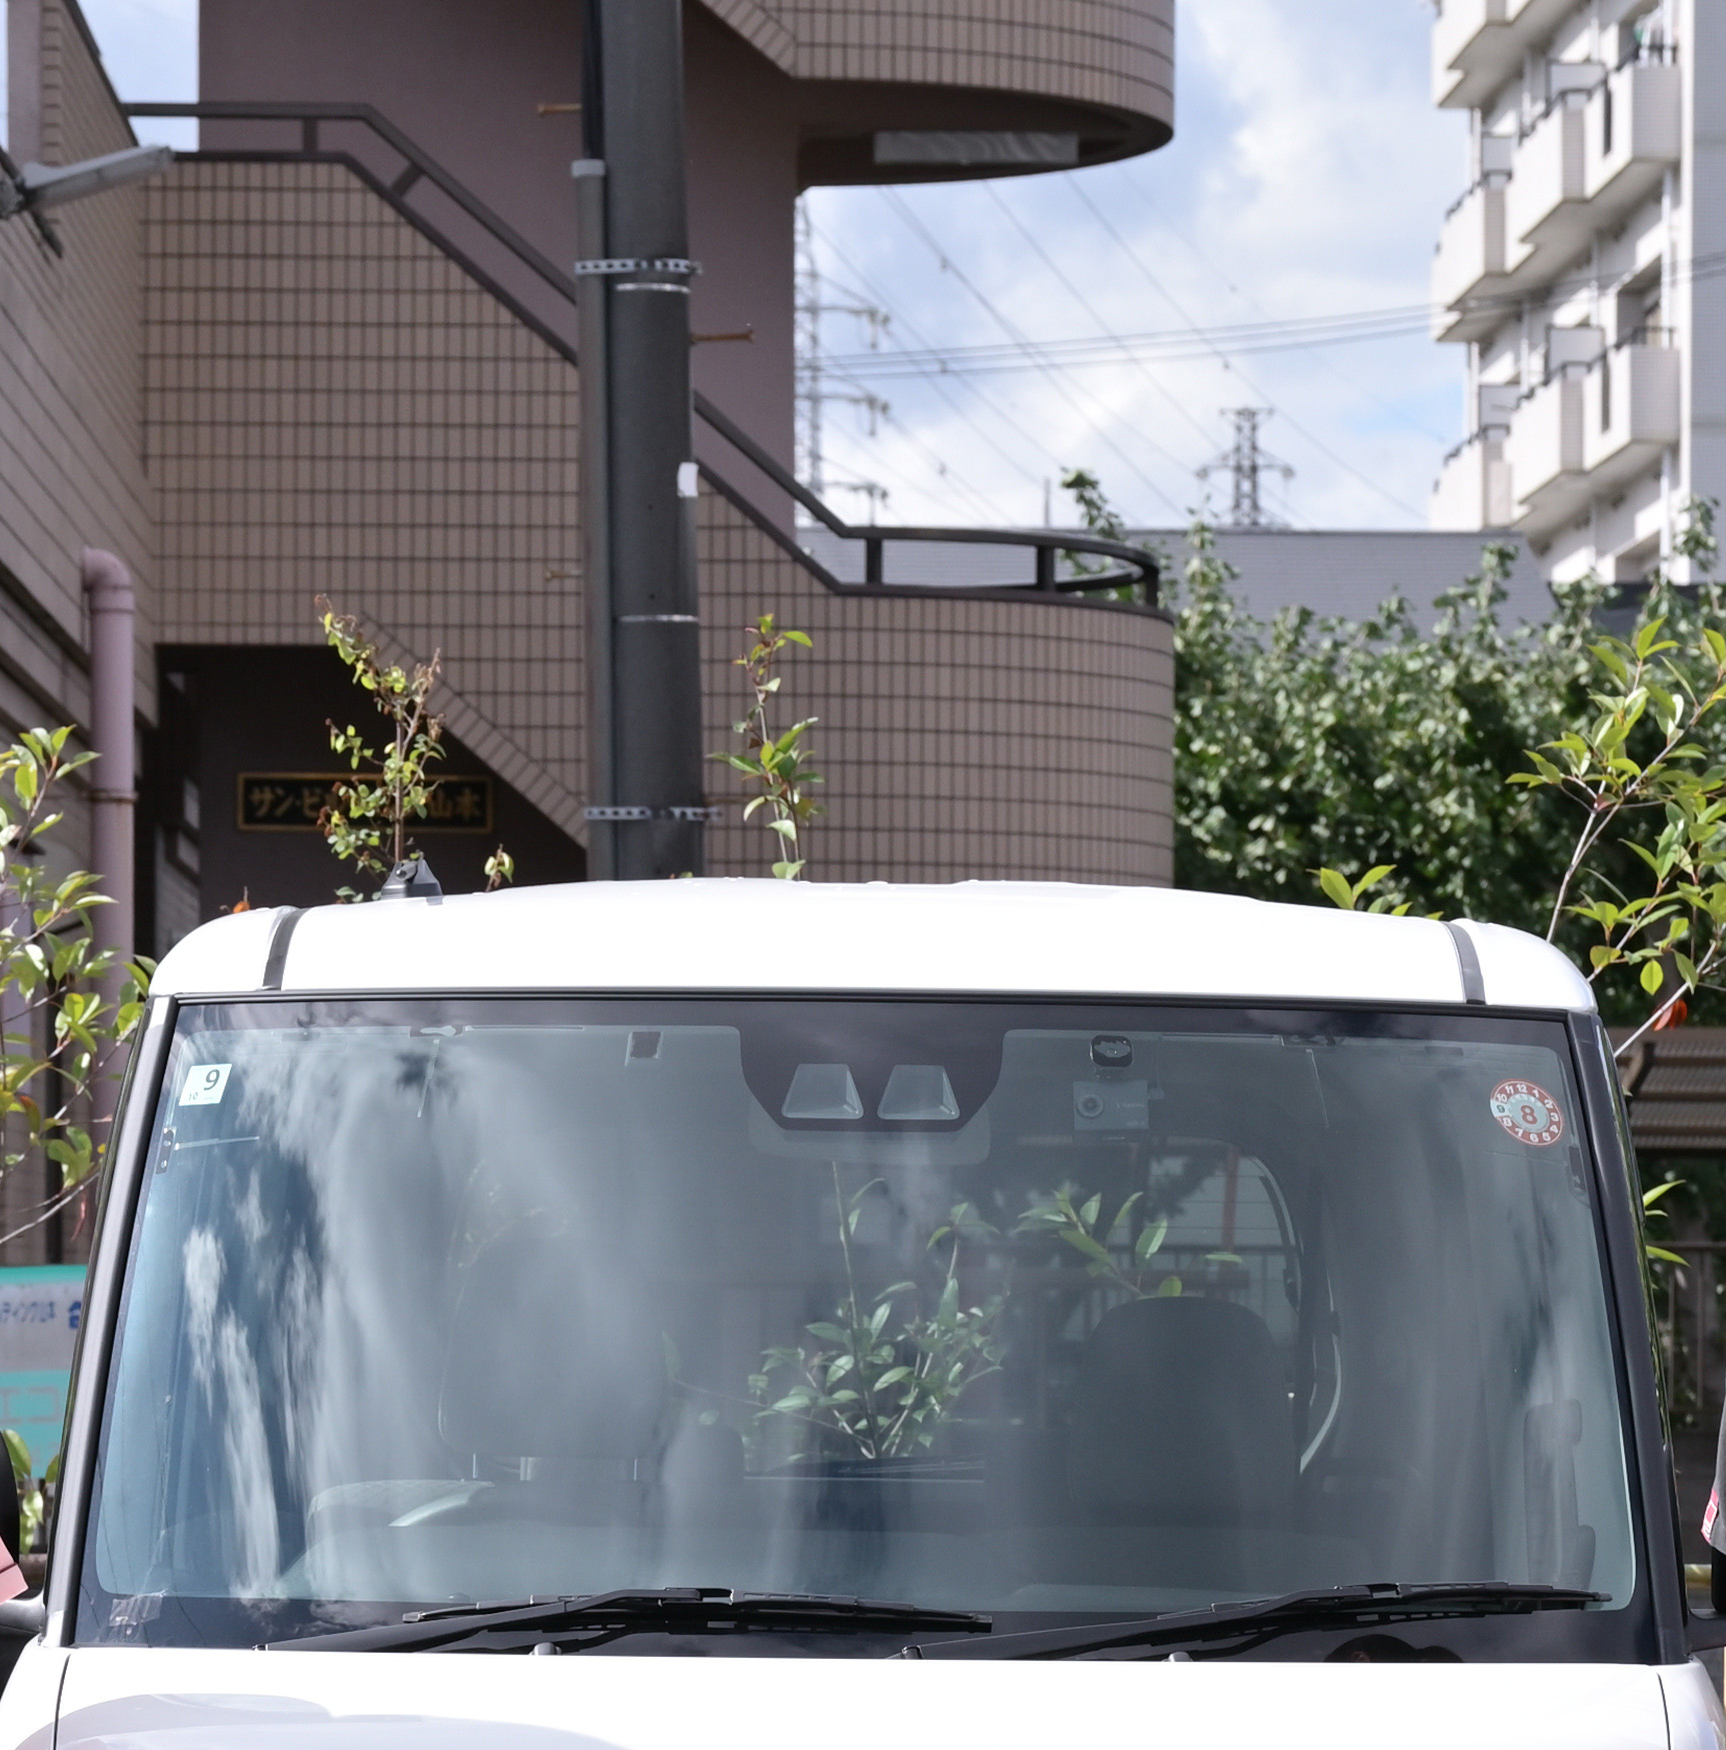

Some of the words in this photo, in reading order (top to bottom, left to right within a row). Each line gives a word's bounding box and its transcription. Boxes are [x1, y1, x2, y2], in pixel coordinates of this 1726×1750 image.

[203, 1068, 220, 1091] 9
[1504, 1085, 1514, 1094] 11
[1516, 1083, 1528, 1093] 12
[1496, 1094, 1508, 1103] 10
[1532, 1089, 1539, 1098] 1
[1496, 1104, 1505, 1113] 9
[1544, 1099, 1554, 1109] 2
[1520, 1104, 1538, 1125] 8
[1550, 1112, 1559, 1122] 3
[1502, 1117, 1512, 1127] 8
[1515, 1128, 1524, 1137] 7
[1550, 1125, 1559, 1134] 4
[1529, 1133, 1539, 1143] 6
[1542, 1132, 1551, 1142] 5
